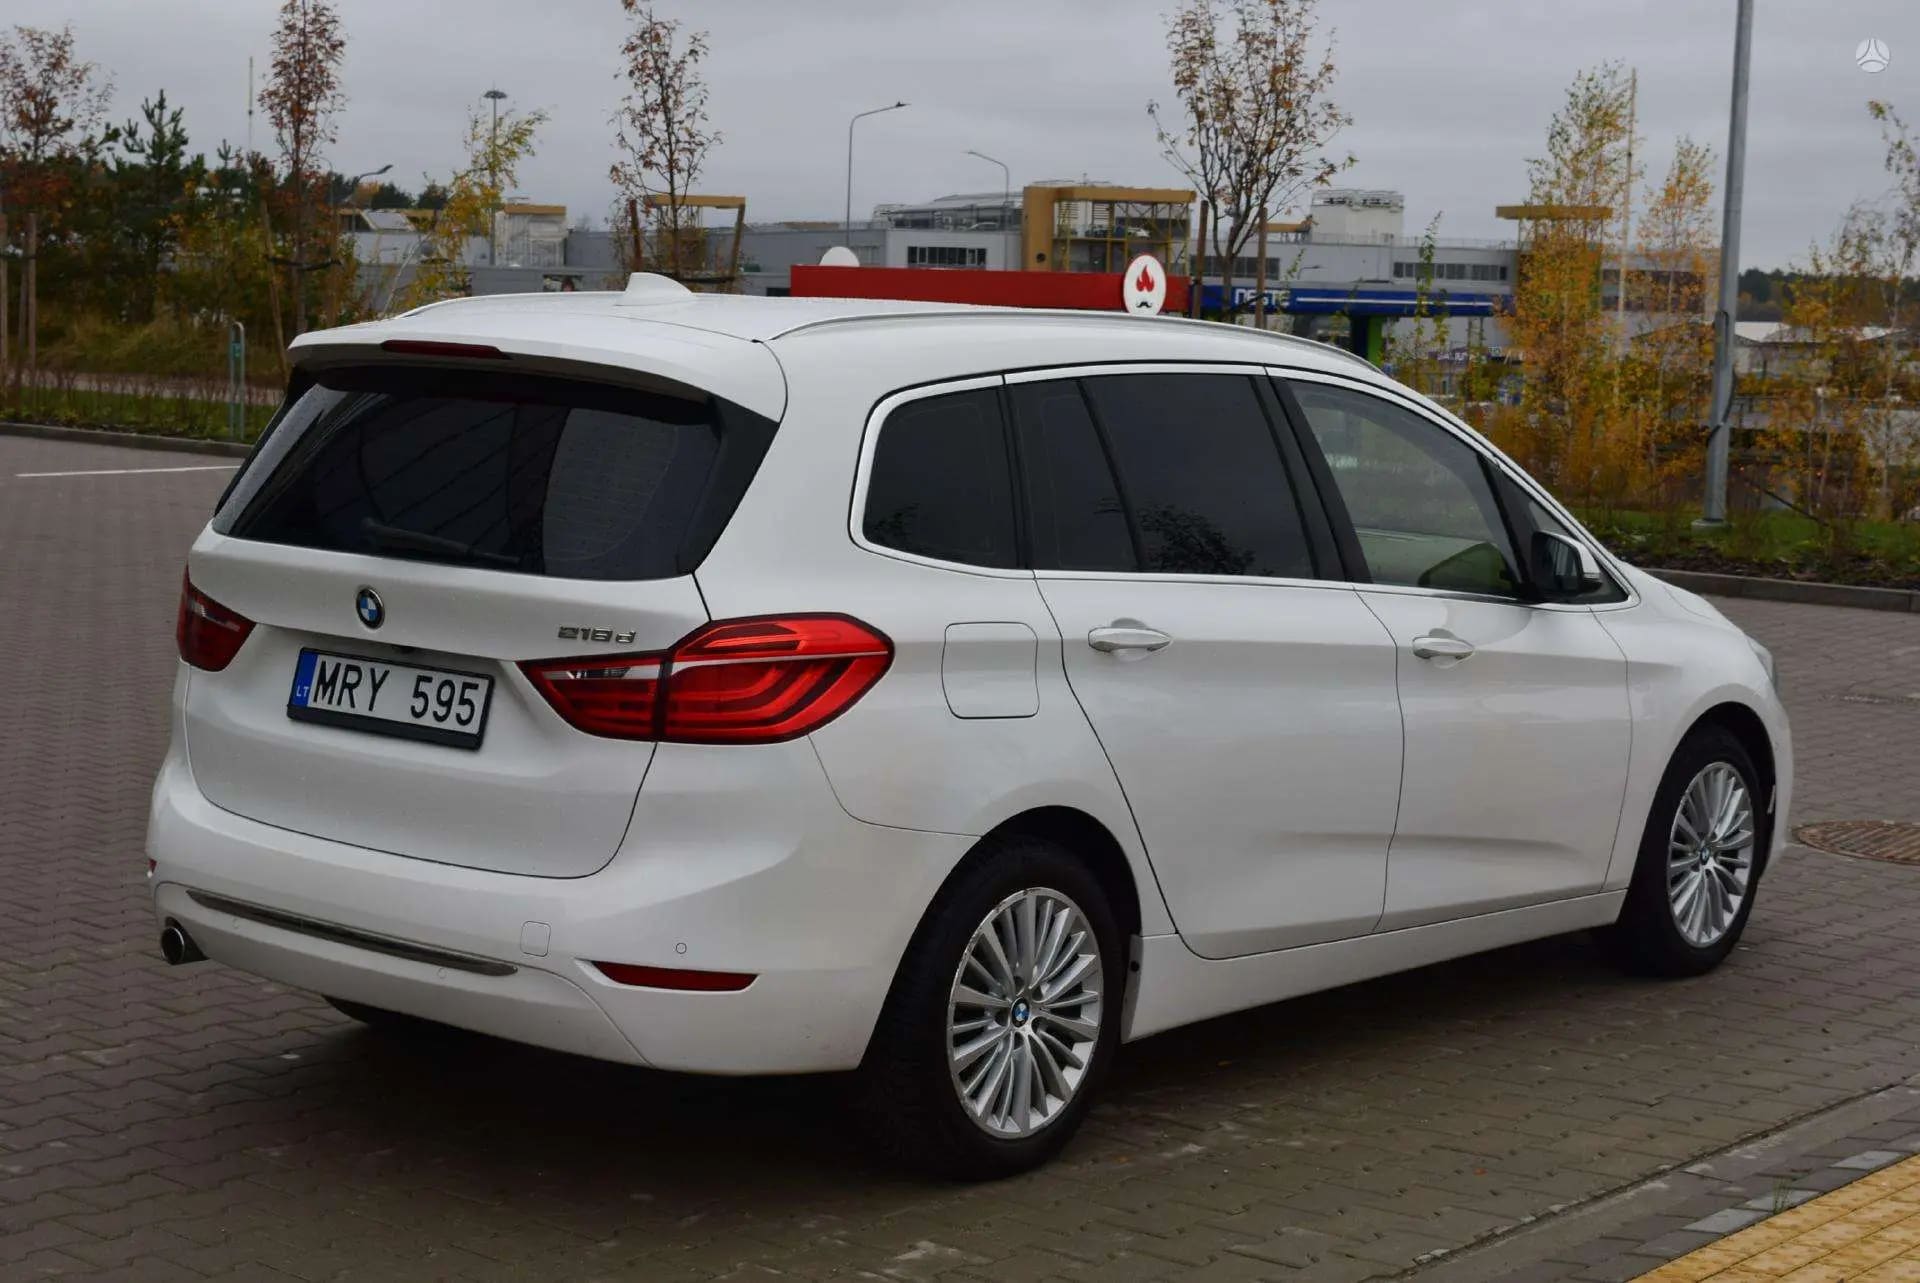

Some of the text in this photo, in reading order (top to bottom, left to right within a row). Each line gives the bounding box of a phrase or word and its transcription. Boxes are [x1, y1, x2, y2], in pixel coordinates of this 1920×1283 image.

[296, 685, 310, 698] LT
[313, 660, 479, 726] MRY 595
